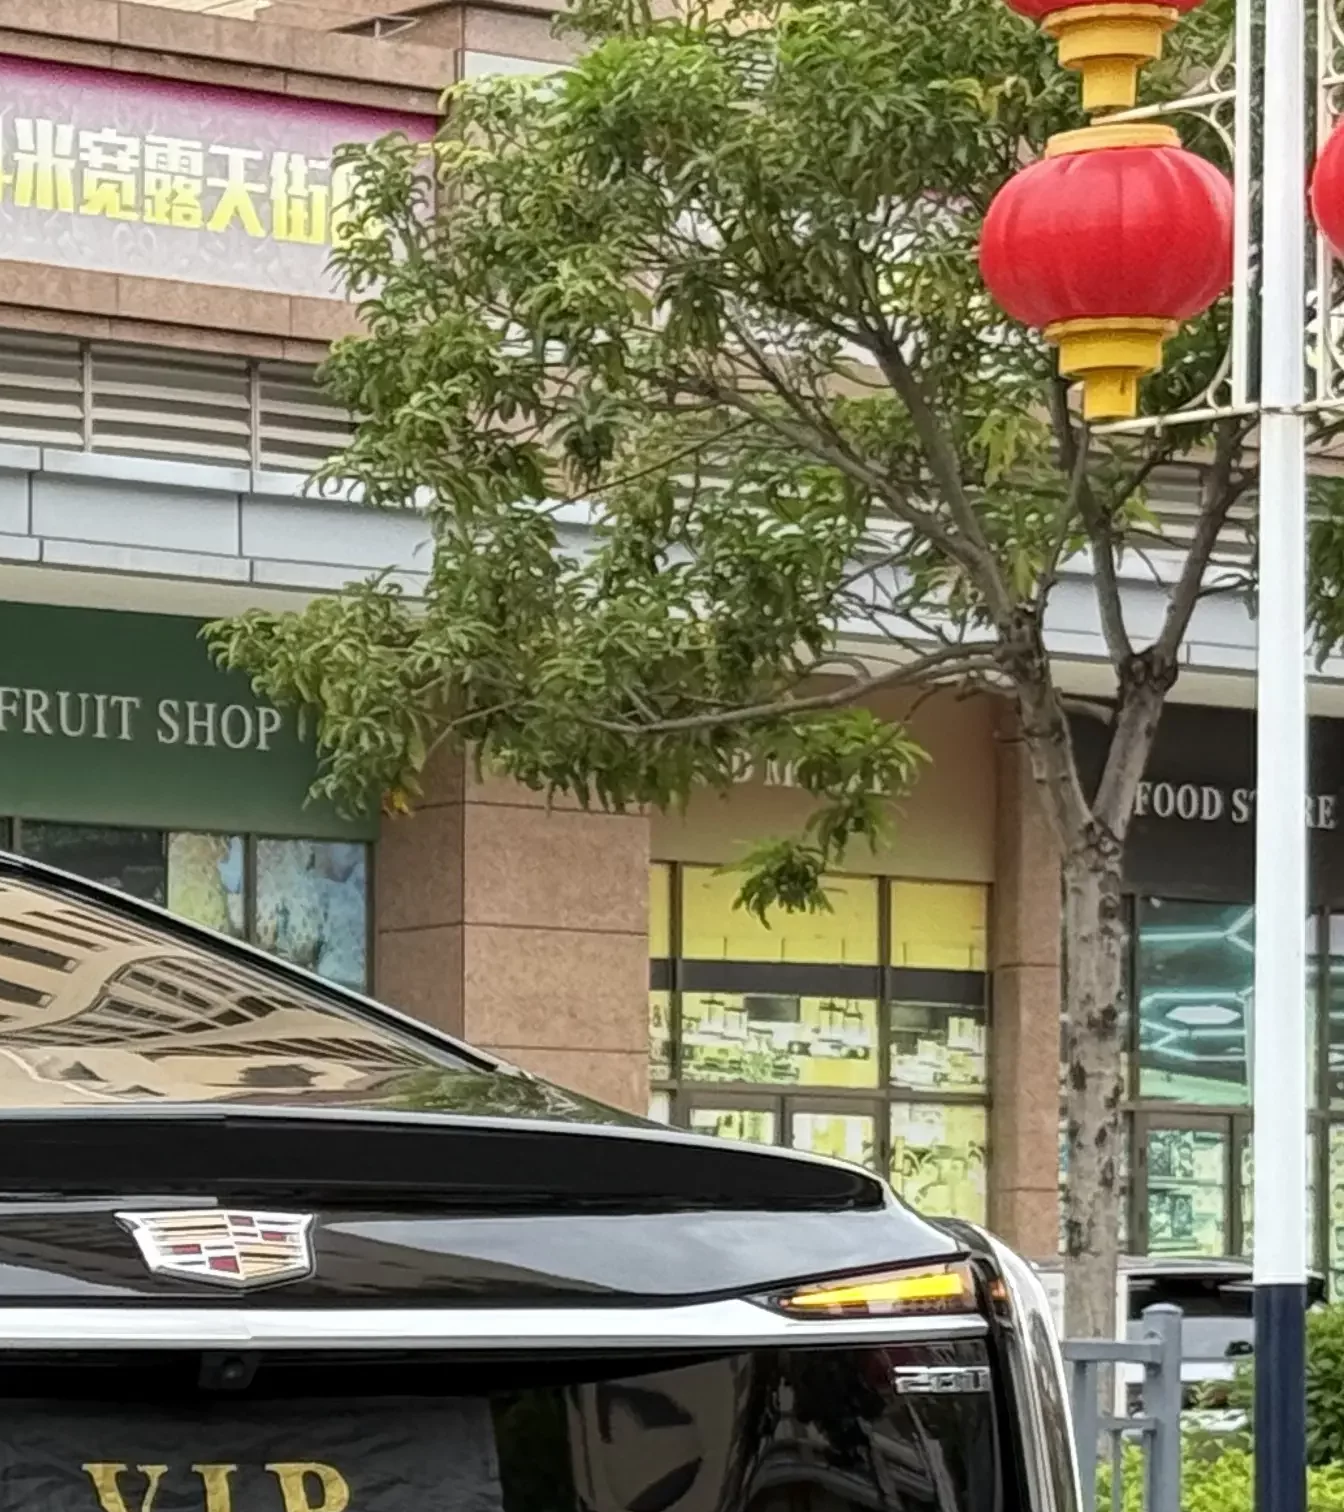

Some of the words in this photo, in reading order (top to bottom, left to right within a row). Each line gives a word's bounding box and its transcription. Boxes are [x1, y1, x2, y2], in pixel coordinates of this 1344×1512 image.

[157, 700, 282, 751] SHOP
[1134, 781, 1224, 820] FOOD
[1231, 788, 1337, 829] SRE
